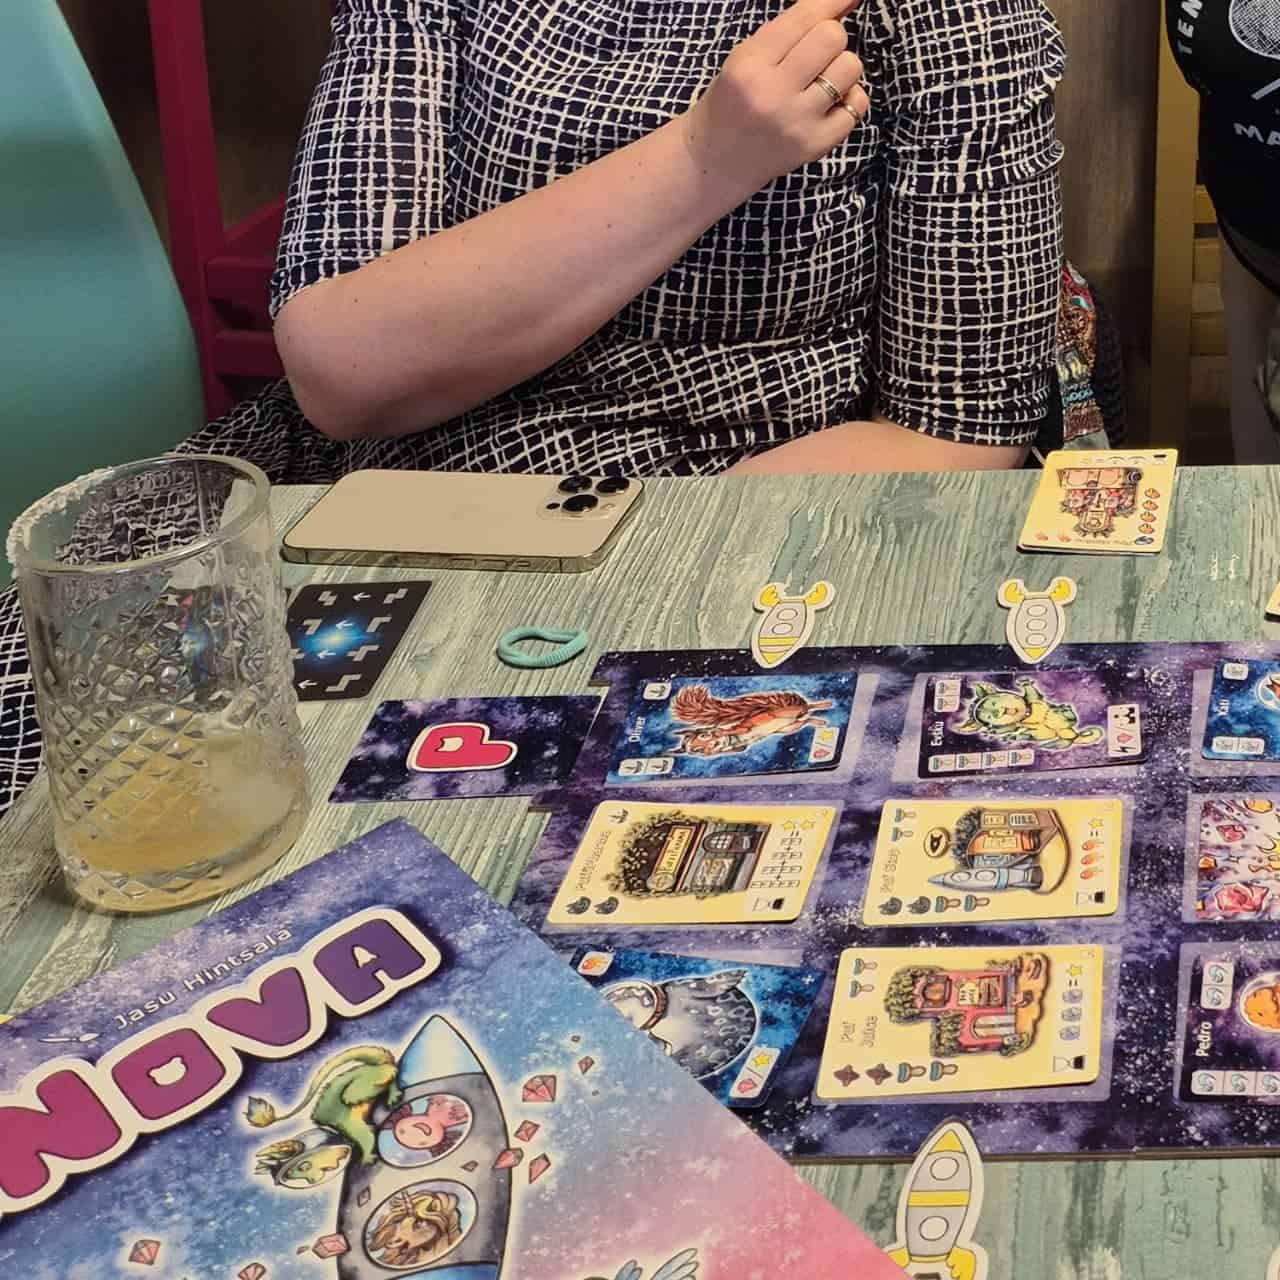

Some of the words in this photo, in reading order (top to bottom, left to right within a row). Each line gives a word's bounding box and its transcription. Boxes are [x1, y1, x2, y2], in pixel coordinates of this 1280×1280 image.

[113, 989, 178, 1031] Jasu
[183, 926, 293, 993] Hintsala
[0, 906, 442, 1214] NOVA
[1194, 1020, 1213, 1057] Pedro
